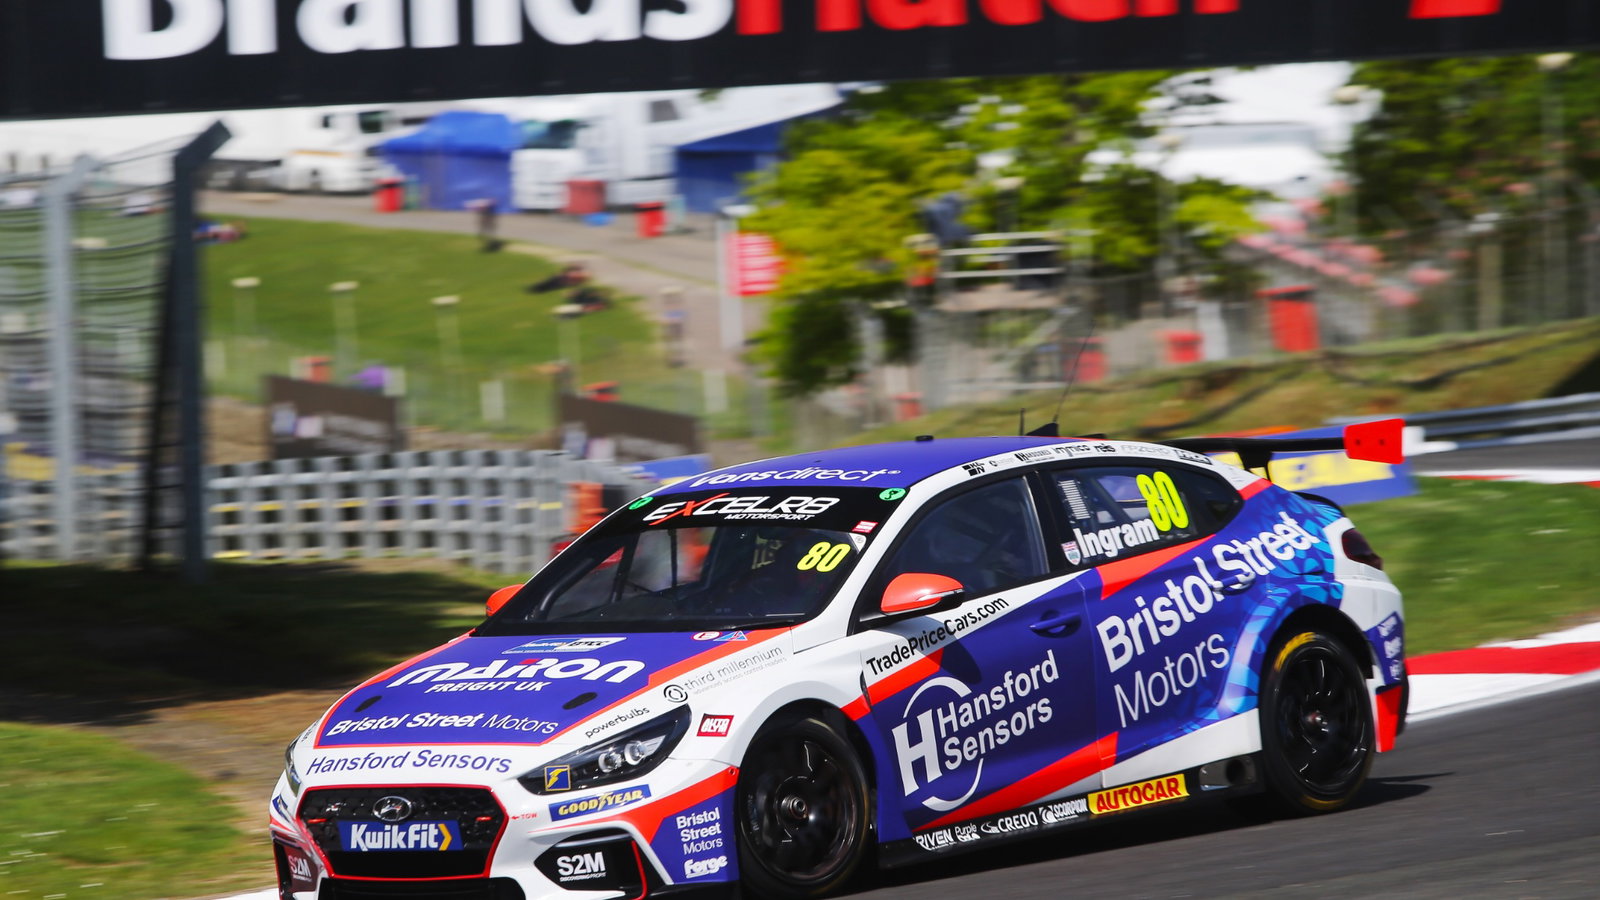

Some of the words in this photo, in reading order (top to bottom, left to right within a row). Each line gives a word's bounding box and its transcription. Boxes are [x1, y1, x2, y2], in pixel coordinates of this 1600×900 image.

[643, 492, 840, 526] EXCELR8
[1136, 471, 1189, 532] 80
[724, 513, 815, 521] MOTORSPORT
[1073, 518, 1160, 558] Ingram
[797, 542, 851, 573] 80
[1096, 557, 1225, 673] Bristol
[1212, 511, 1320, 591] Street
[866, 597, 1010, 678] TradePriceCars.com
[684, 671, 716, 690] third
[716, 646, 783, 678] millennium
[1113, 632, 1230, 728] Motors
[424, 681, 516, 693] FREIGHT
[513, 681, 552, 691] UK
[937, 649, 1059, 739] Hansford
[326, 715, 411, 737] Bristol
[406, 712, 484, 728] Street
[482, 714, 559, 734] Motors
[585, 706, 650, 738] powerbulbs
[943, 696, 1053, 770] Sensors
[305, 750, 410, 776] Hansford
[412, 749, 512, 773] Sensors
[558, 789, 643, 815] GOODYEAR
[1096, 777, 1182, 813] AUTOCAR
[676, 806, 720, 829] Bristol
[680, 822, 722, 842] Street
[997, 811, 1038, 832] CREDO
[683, 837, 723, 855] Motors
[288, 855, 312, 877] S2M
[556, 851, 606, 876] S2M
[684, 855, 728, 879] Forge
